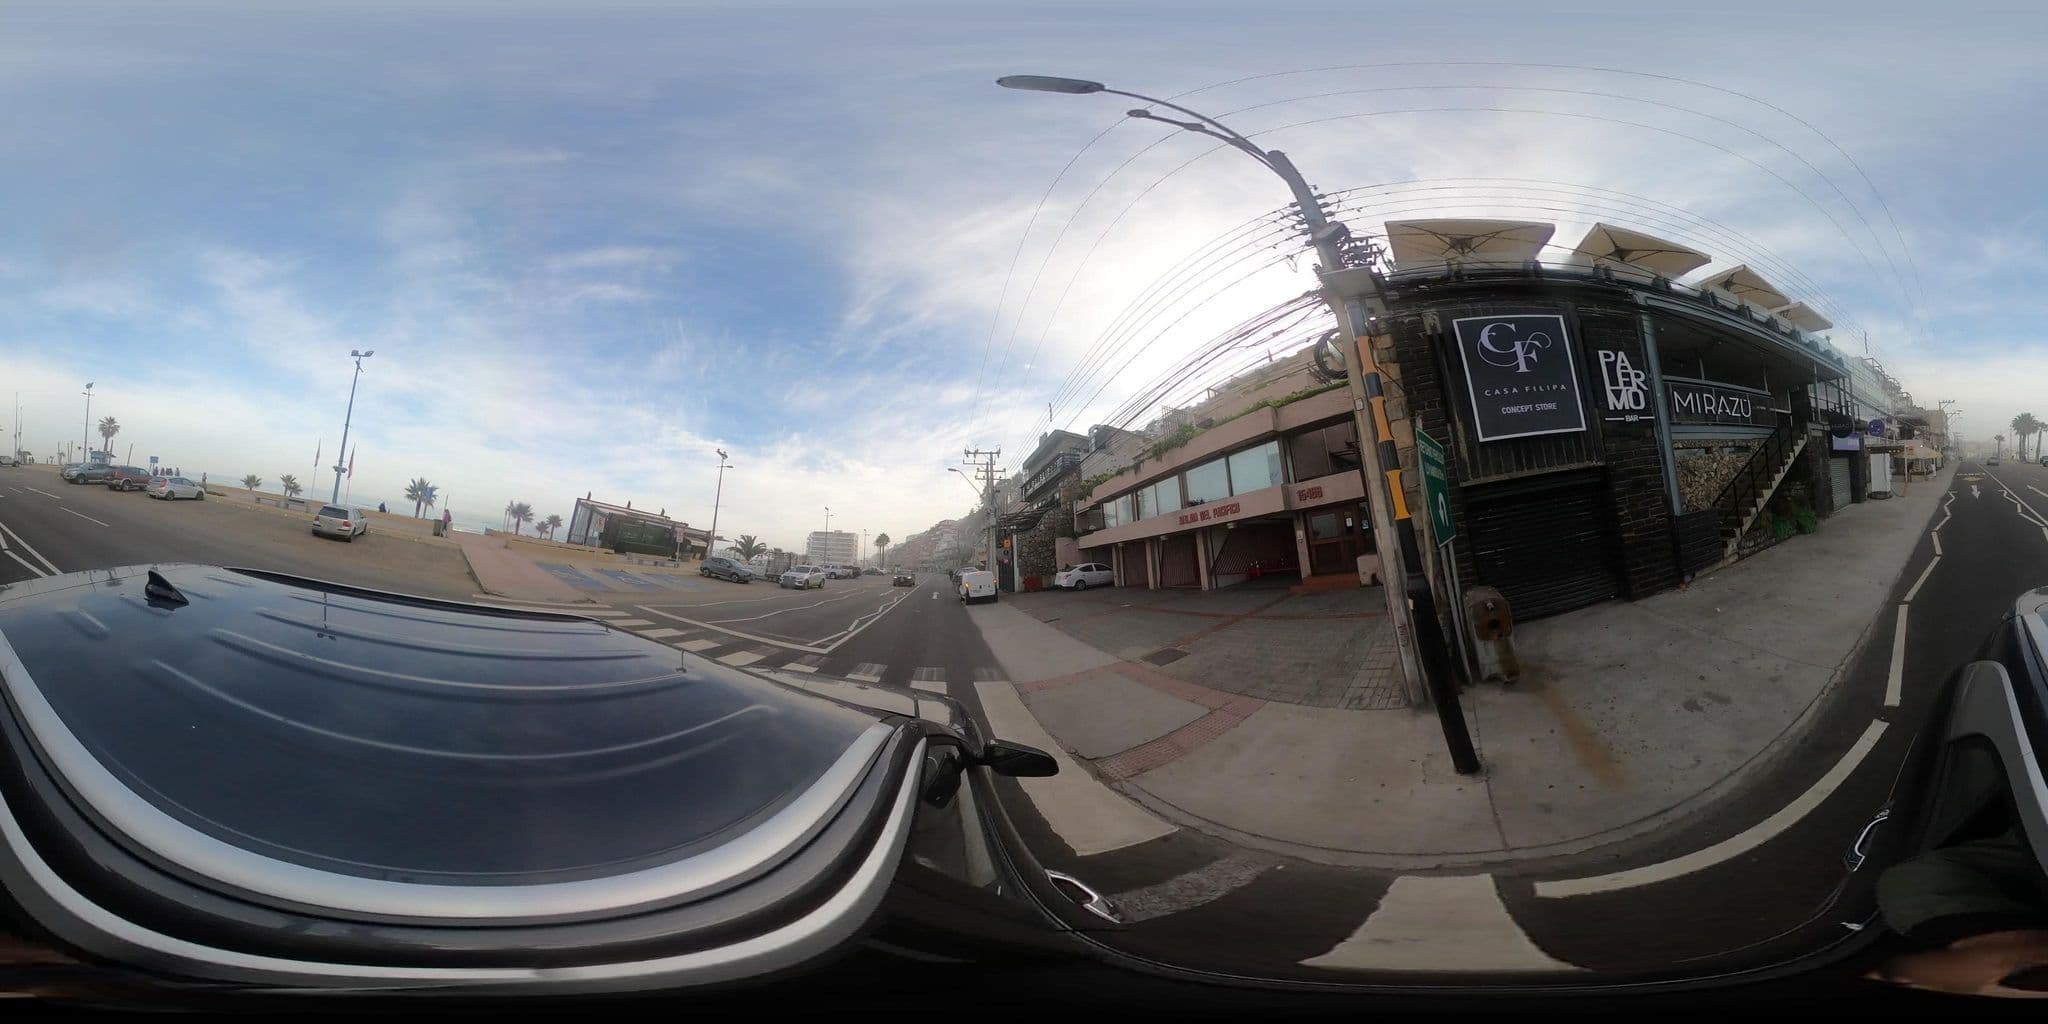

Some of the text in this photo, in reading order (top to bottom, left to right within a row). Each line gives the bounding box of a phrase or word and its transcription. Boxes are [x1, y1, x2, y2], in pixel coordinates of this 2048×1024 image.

[1484, 384, 1567, 397] CASA FILIPA
[1501, 402, 1558, 415] CONCEPT STORE
[1625, 414, 1639, 422] BAR
